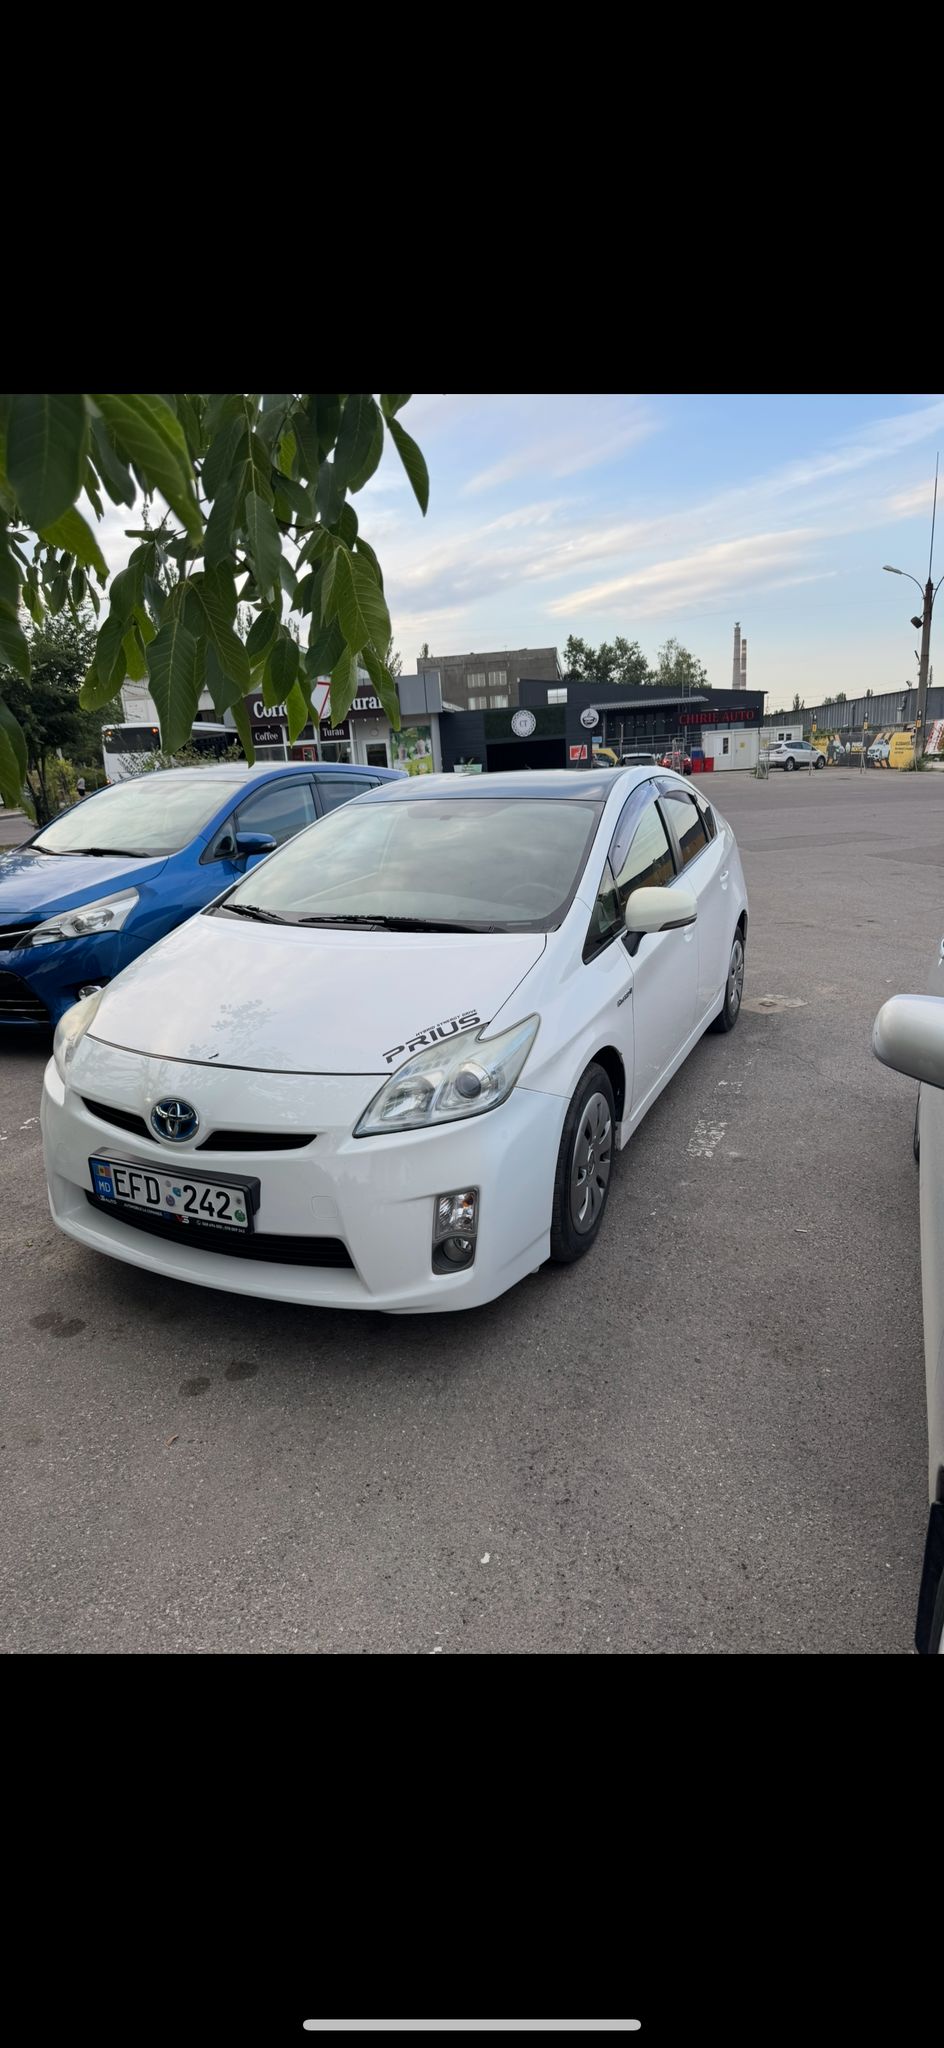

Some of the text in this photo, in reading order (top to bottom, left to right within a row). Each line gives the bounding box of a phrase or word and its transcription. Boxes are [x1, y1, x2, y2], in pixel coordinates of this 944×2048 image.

[679, 709, 755, 725] CHIRIE AUTO
[254, 731, 279, 742] Coffee
[322, 727, 345, 738] Turan
[382, 1012, 481, 1064] PRIUS
[98, 1180, 111, 1194] MD
[113, 1168, 161, 1205] EFD
[183, 1184, 233, 1221] 242
